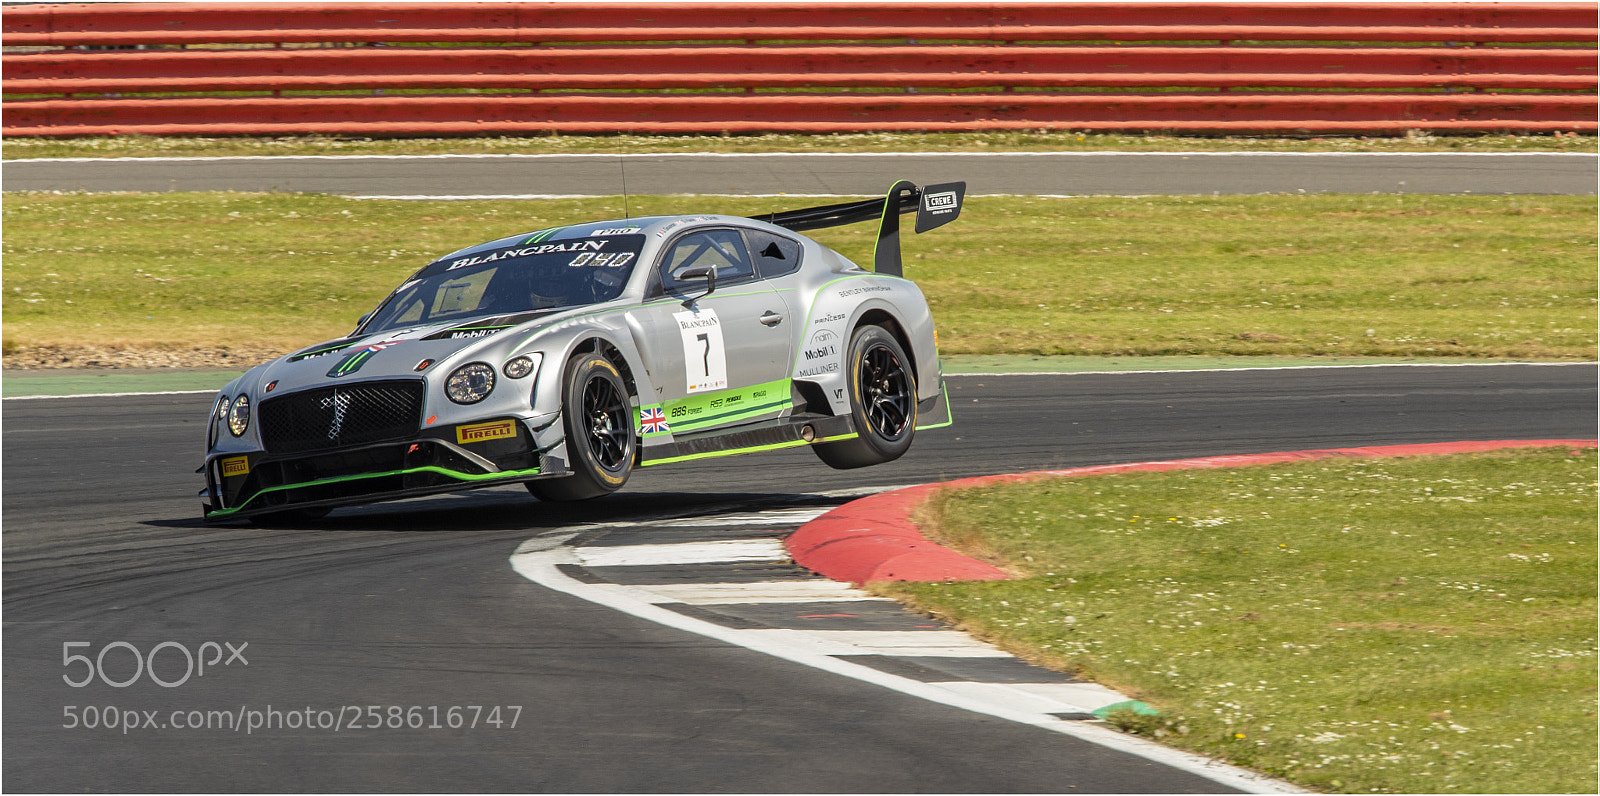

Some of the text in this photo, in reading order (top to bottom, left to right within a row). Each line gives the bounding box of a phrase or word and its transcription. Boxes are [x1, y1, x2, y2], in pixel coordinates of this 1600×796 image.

[446, 240, 609, 271] BLANCPAIN
[838, 288, 862, 297] BENTLEY
[680, 317, 718, 329] BLANCPAIN
[814, 313, 846, 325] PRINCESS
[697, 333, 710, 377] 7
[805, 346, 829, 360] Mobil
[799, 362, 840, 377] MULLINER
[671, 405, 687, 417] BBS
[461, 423, 511, 440] PIRELLI
[223, 459, 247, 473] PIRELLI
